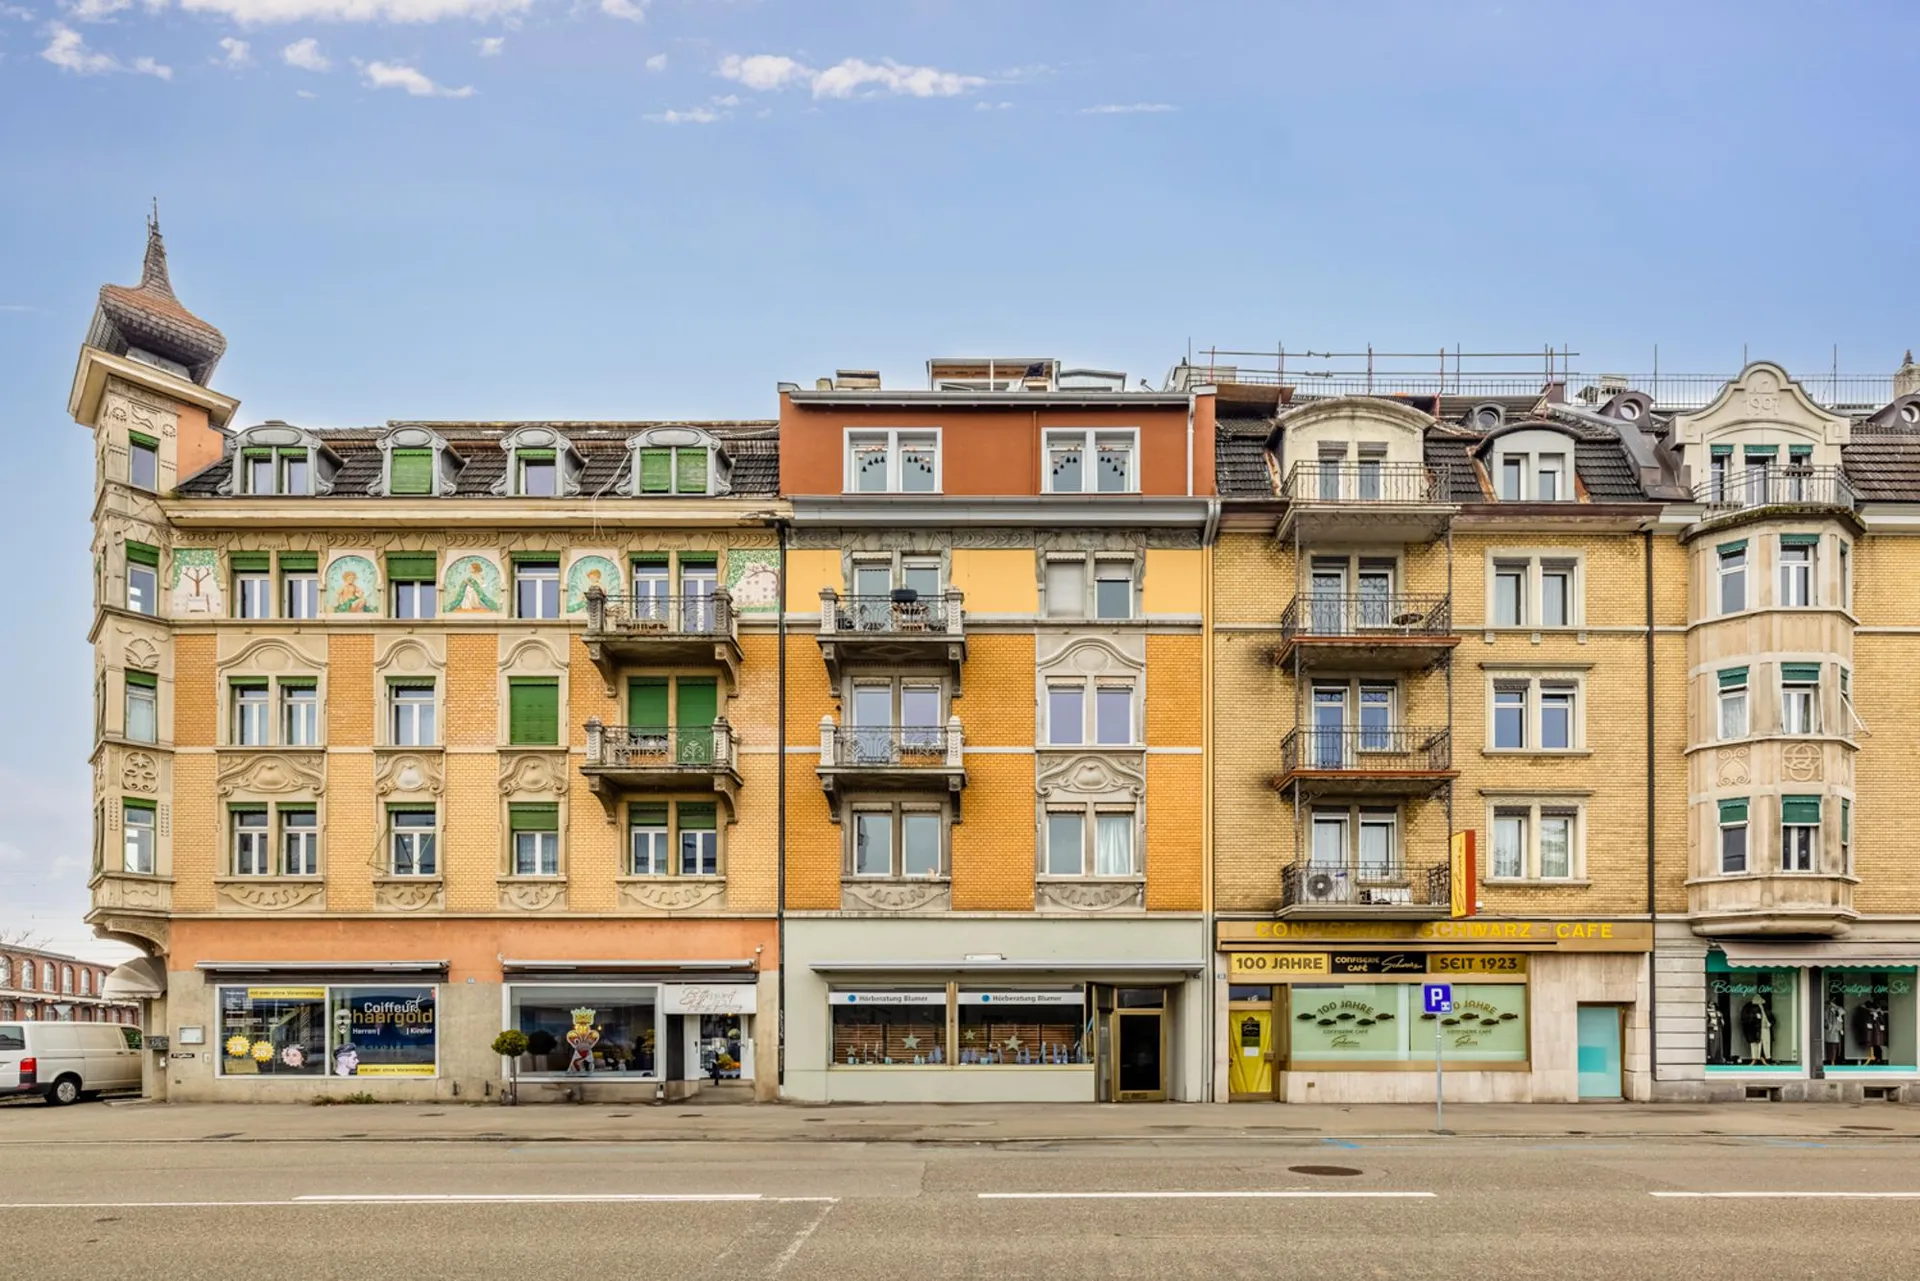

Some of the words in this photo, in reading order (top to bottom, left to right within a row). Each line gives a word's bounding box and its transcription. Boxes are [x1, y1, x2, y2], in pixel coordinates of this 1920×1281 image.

[1420, 922, 1532, 938] SCHWARZ
[1555, 923, 1613, 938] CAFE
[1236, 957, 1267, 970] 100
[1271, 957, 1323, 970] JAHRE
[1440, 957, 1476, 970] SEIT
[1480, 957, 1518, 970] 1923
[1431, 988, 1443, 1007] P
[1317, 1002, 1337, 1015] 100
[1340, 1000, 1374, 1015] JAHRE
[1464, 1000, 1498, 1015] JAHRE
